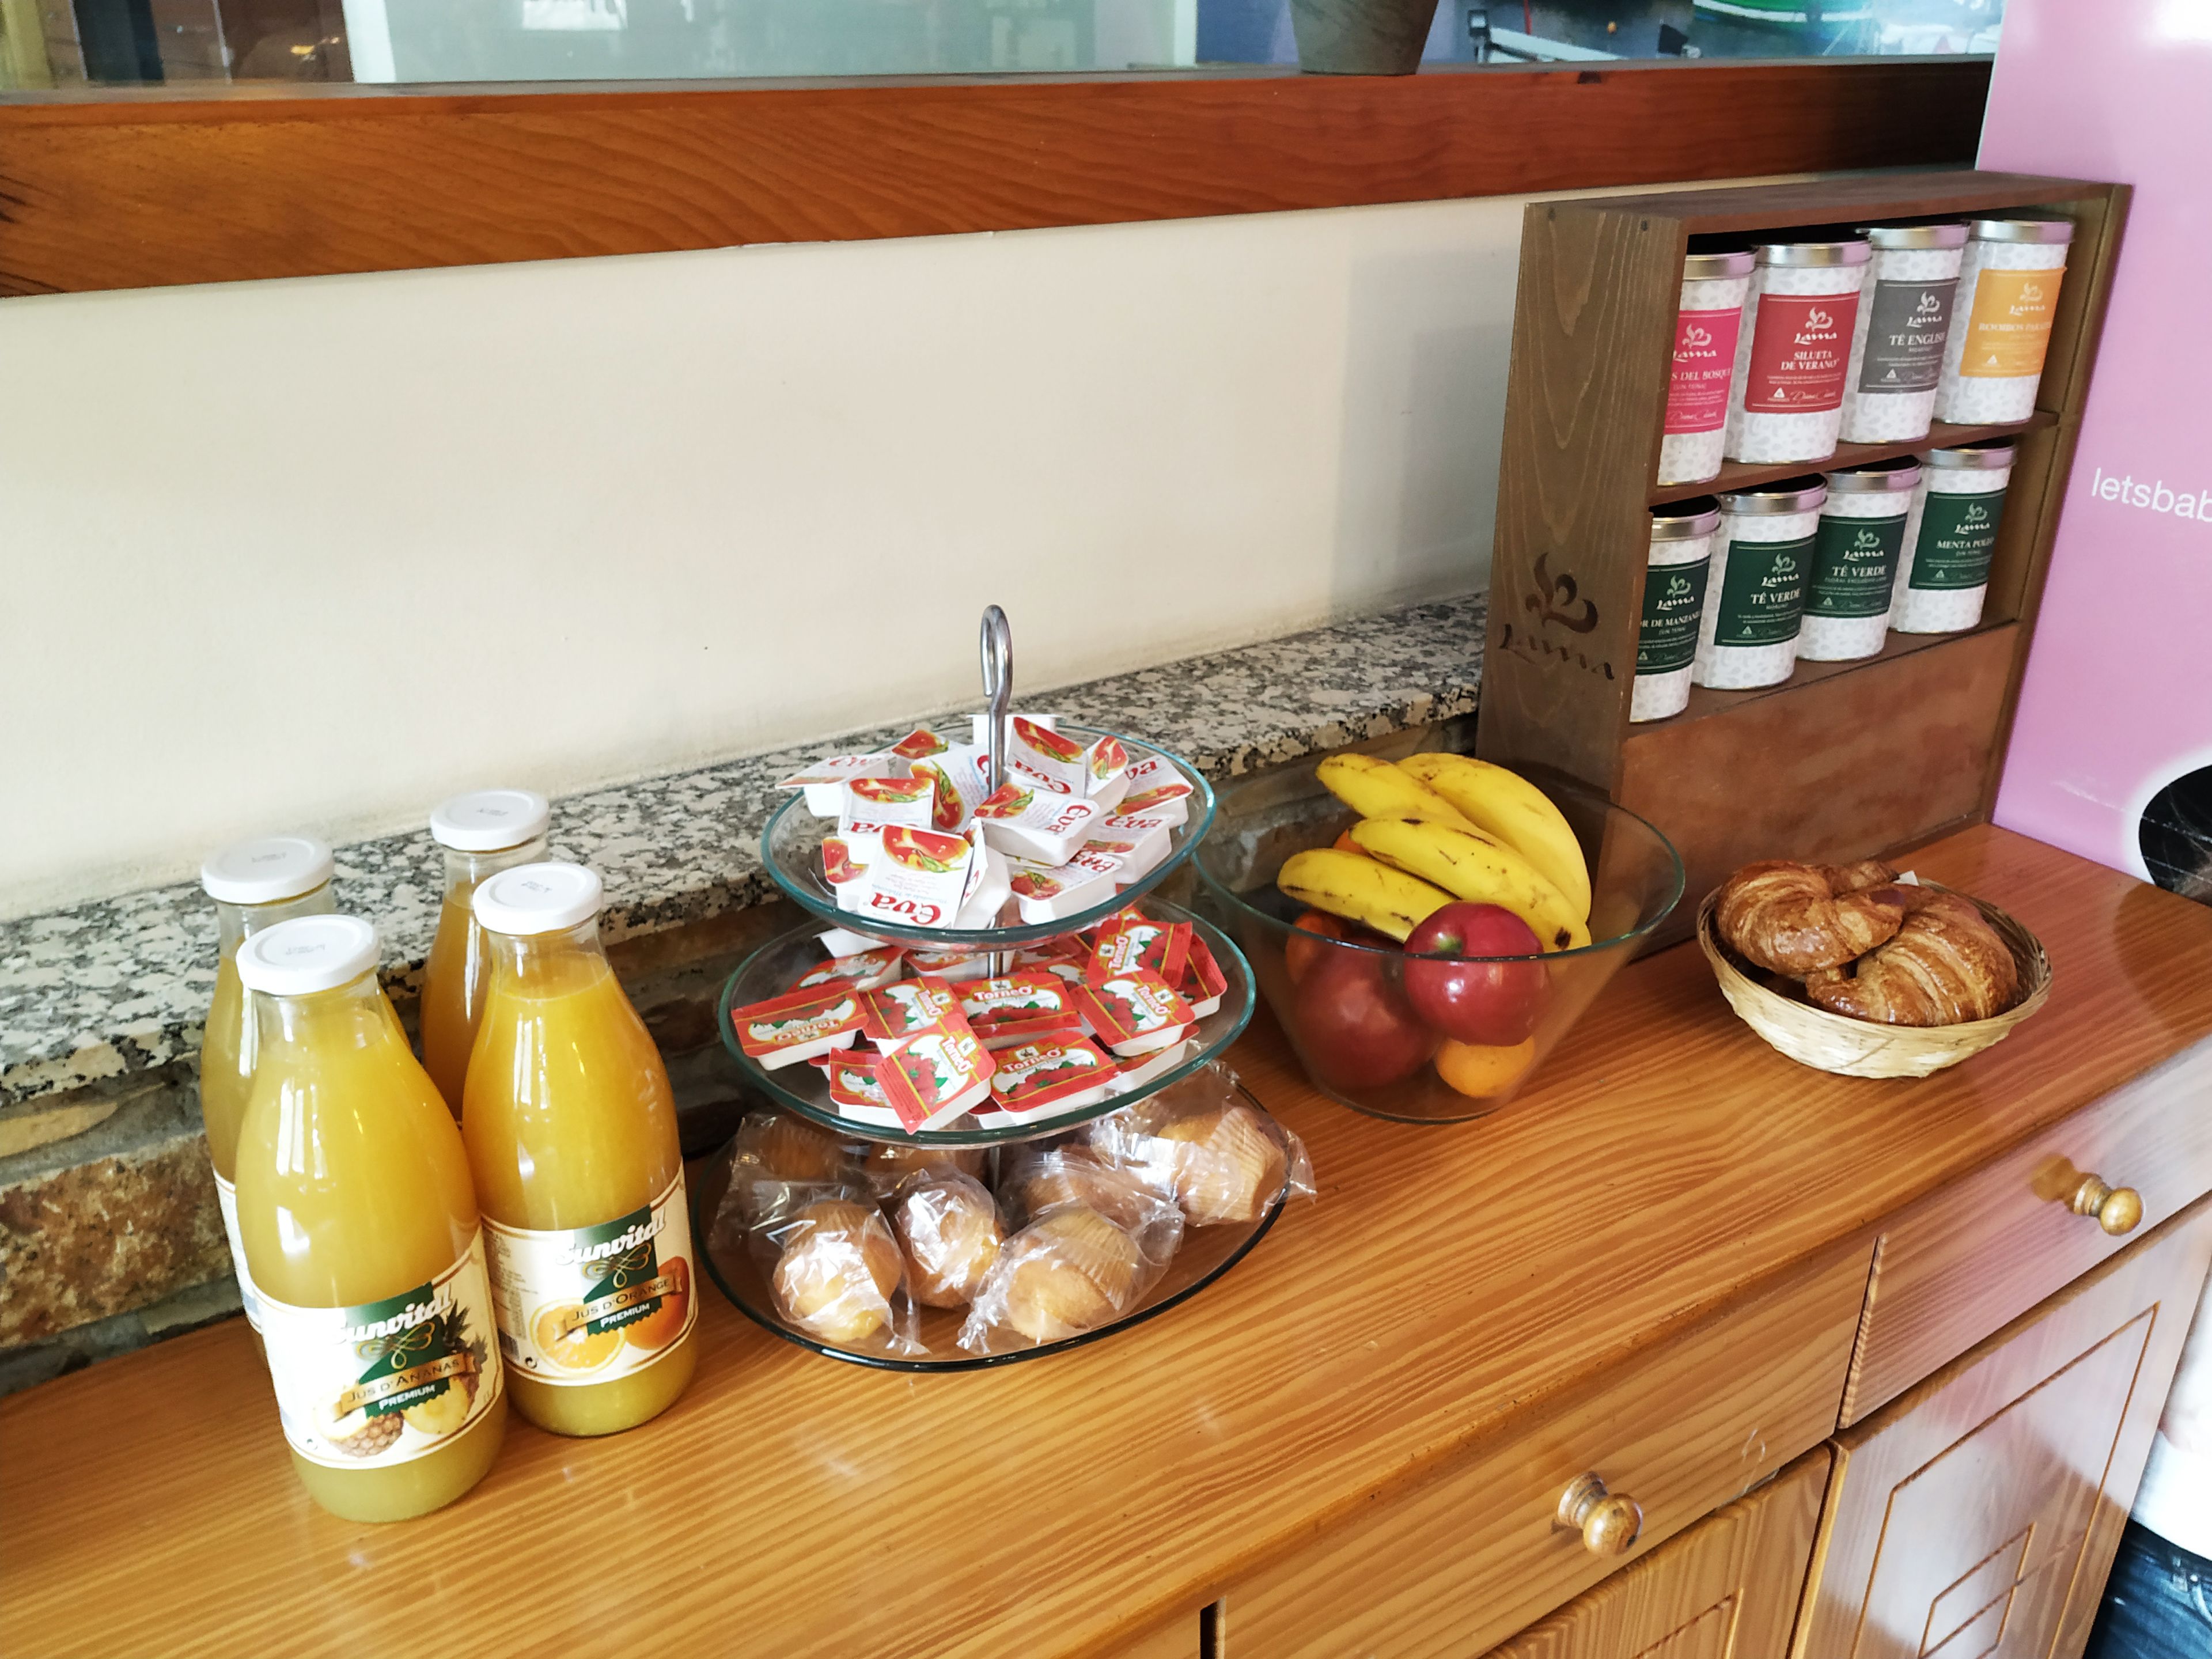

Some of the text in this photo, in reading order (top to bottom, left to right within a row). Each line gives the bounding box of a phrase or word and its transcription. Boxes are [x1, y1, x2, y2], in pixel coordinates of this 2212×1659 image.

[1906, 316, 1943, 328] Lama
[1793, 332, 1838, 346] Lama
[1793, 350, 1832, 361] SILUETA
[1781, 359, 1838, 371] DE VERANO
[1680, 371, 1700, 381] DEL
[1954, 522, 1991, 535] Lama
[1936, 540, 1971, 550] MENTA
[1843, 550, 1884, 562] Lama
[1832, 564, 1887, 577] TÉ VERDE
[1761, 573, 1800, 588] Lama
[1656, 596, 1695, 611] Lama
[1750, 591, 1767, 604] TÉ
[1125, 760, 1158, 780] va
[1014, 760, 1072, 794] Eva
[1044, 804, 1093, 834] Eva
[1105, 816, 1162, 829] Eva
[870, 892, 941, 925] Eva
[555, 1206, 666, 1266] Sunvital
[600, 1302, 650, 1328] PREMIUM
[378, 1385, 435, 1411] PREMIUM
